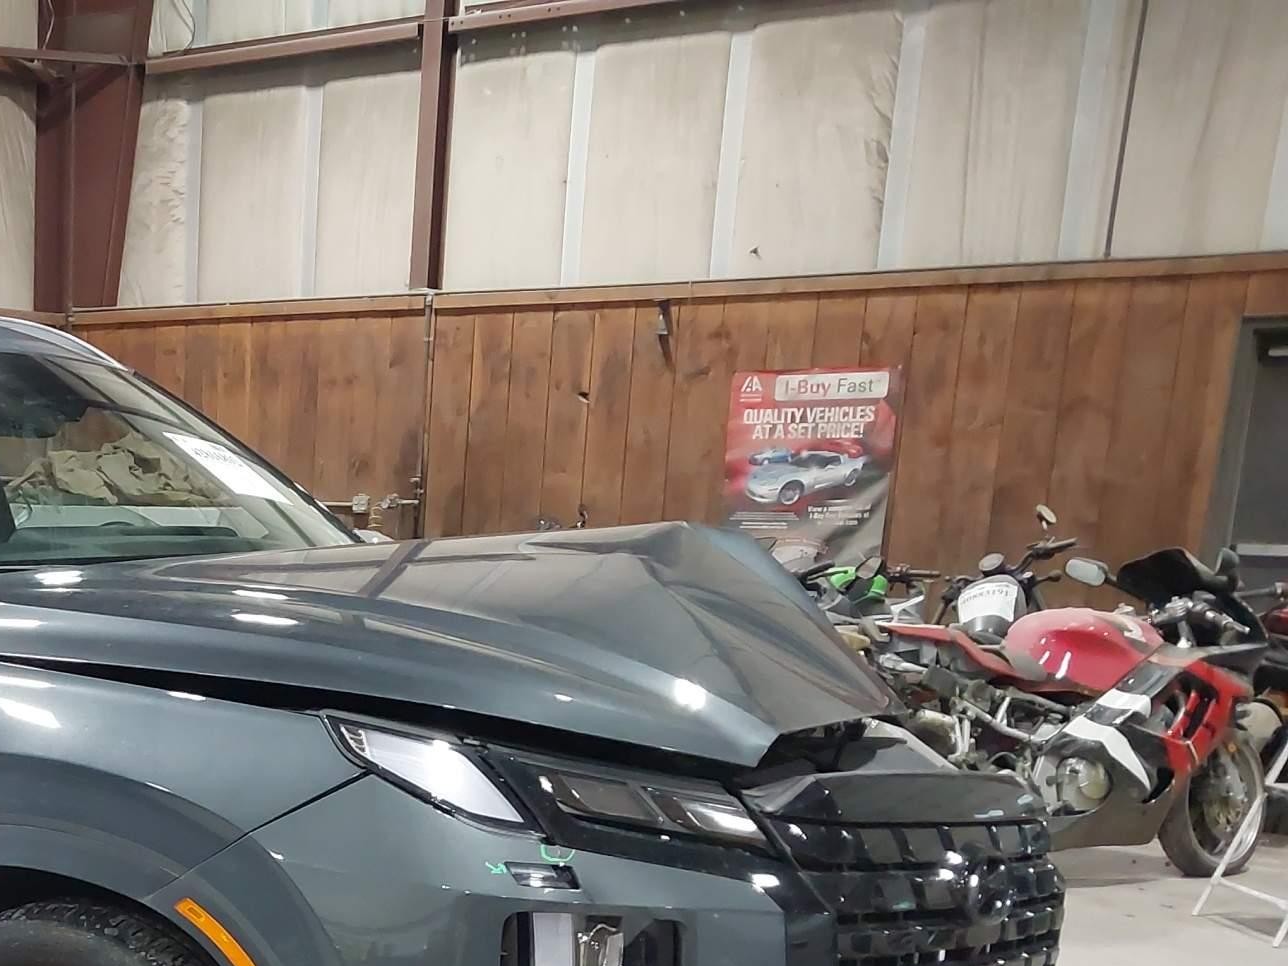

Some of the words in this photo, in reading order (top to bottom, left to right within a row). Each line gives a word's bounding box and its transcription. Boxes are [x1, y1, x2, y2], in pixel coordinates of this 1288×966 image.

[785, 379, 831, 396] I-Buy
[837, 377, 874, 393] Fast
[743, 407, 805, 425] QUALITY
[806, 405, 876, 423] VEHICLES
[752, 424, 773, 440] AT
[774, 425, 786, 440] A
[787, 423, 817, 439] SET
[817, 422, 865, 438] PRICE!
